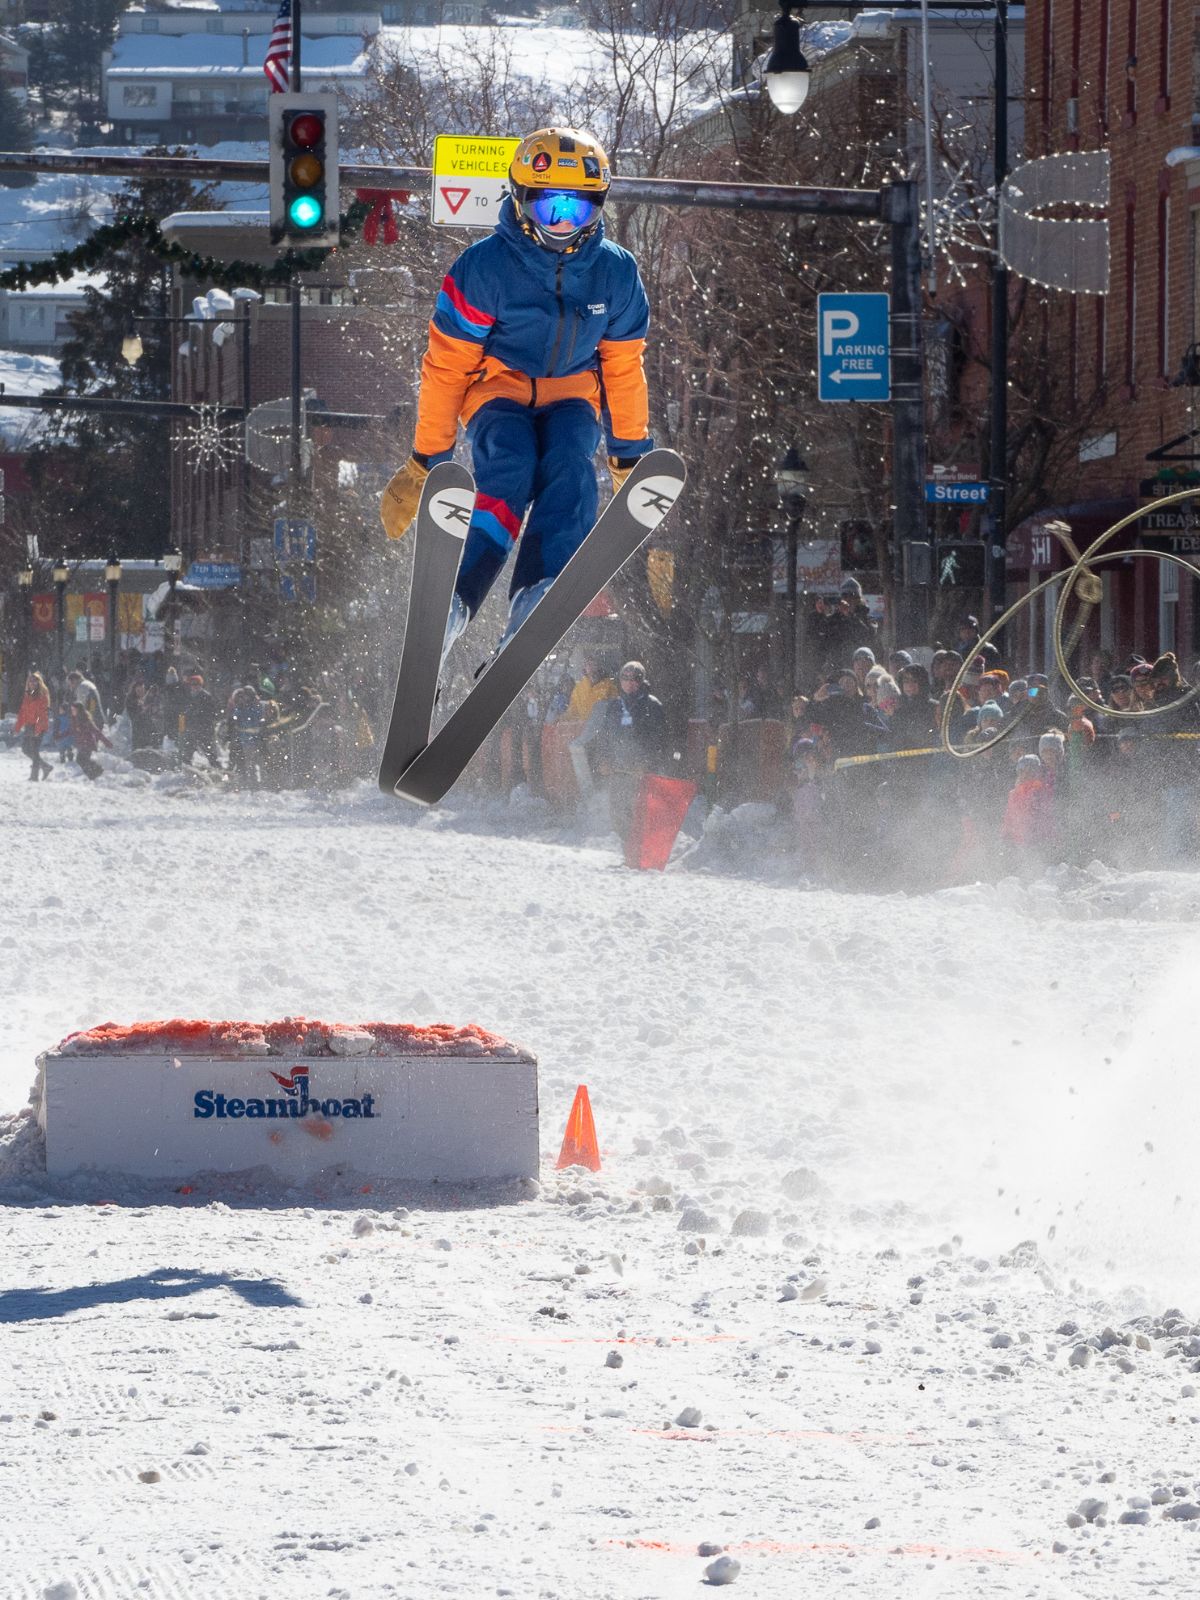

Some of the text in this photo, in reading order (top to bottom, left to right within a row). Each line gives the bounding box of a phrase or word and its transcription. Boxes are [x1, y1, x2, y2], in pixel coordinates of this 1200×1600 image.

[454, 144, 505, 156] TURNING
[451, 160, 508, 172] VEHICLES
[474, 196, 488, 206] TO
[841, 359, 873, 370] FREE
[957, 472, 977, 480] District
[935, 486, 987, 500] Street
[194, 1077, 374, 1118] Steamboat
